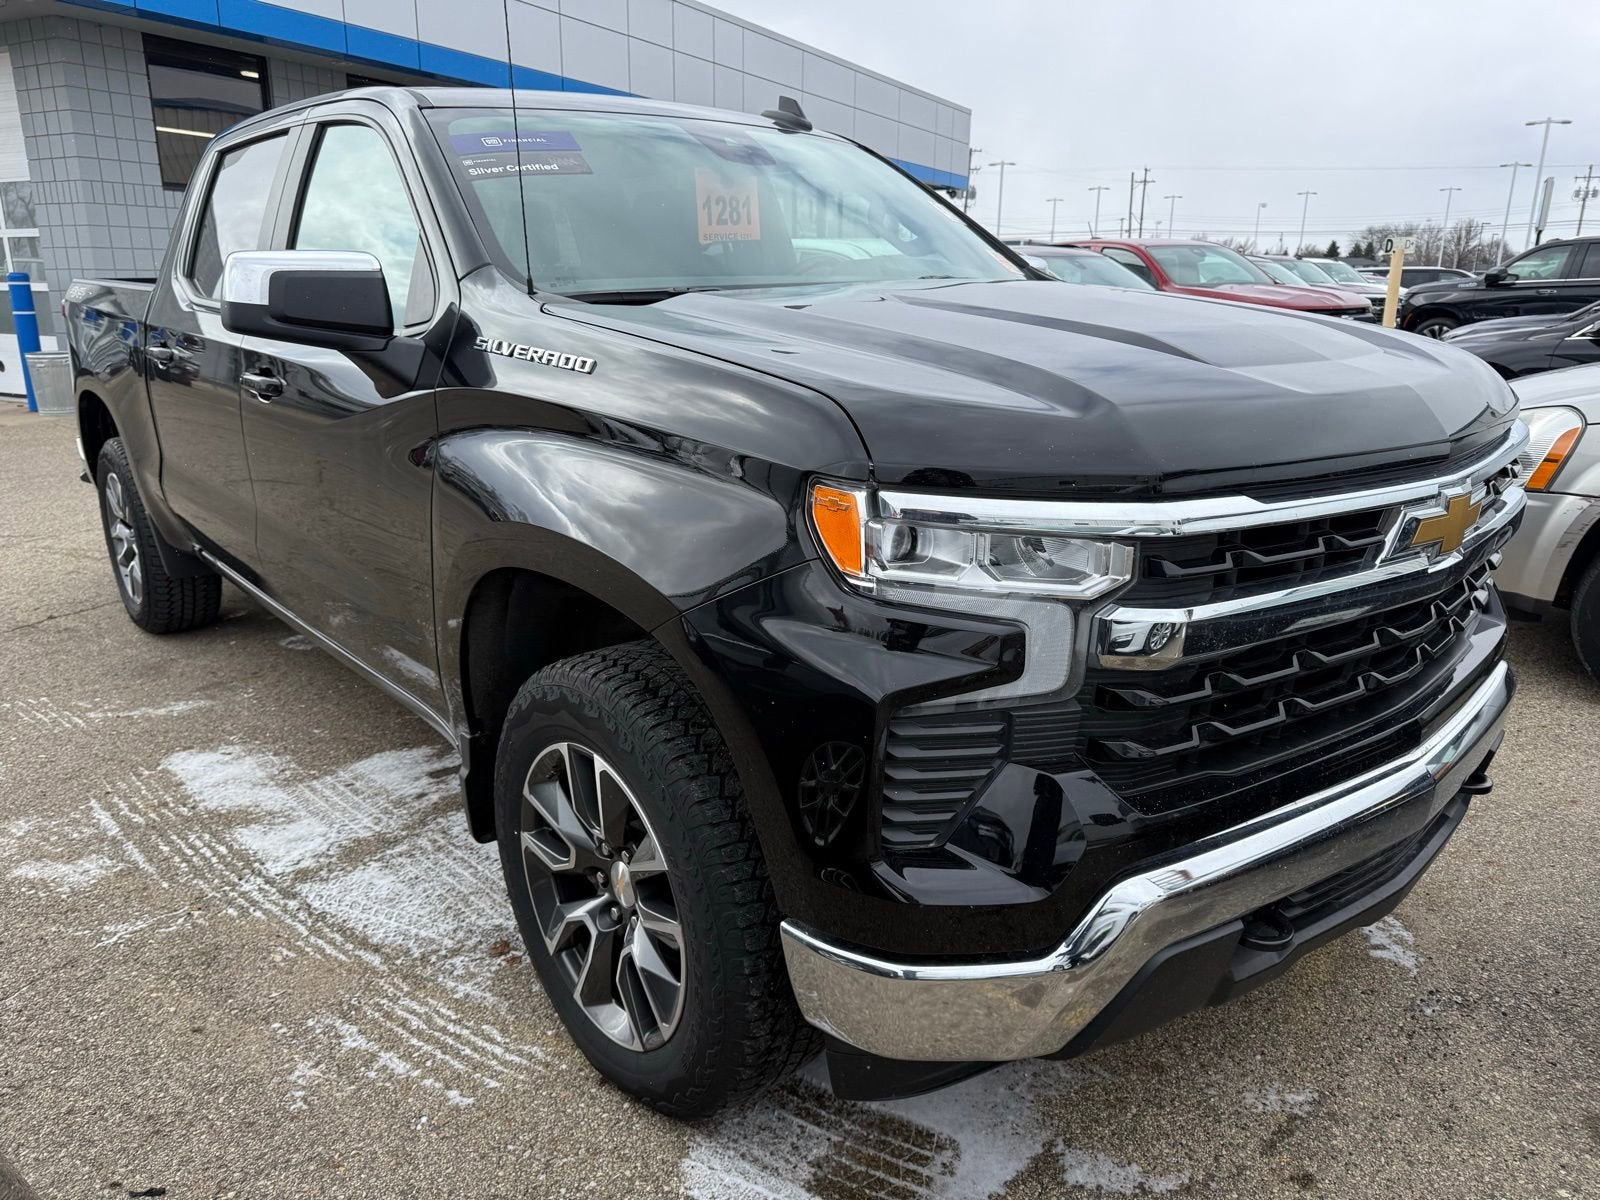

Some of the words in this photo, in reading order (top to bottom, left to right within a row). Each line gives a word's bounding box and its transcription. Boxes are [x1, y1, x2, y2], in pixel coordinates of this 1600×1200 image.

[468, 166, 505, 176] Silver
[506, 163, 560, 172] Certified
[702, 195, 752, 226] 1281
[703, 232, 738, 241] SERVICE
[1385, 238, 1394, 254] D
[473, 336, 597, 374] SILVERADO
